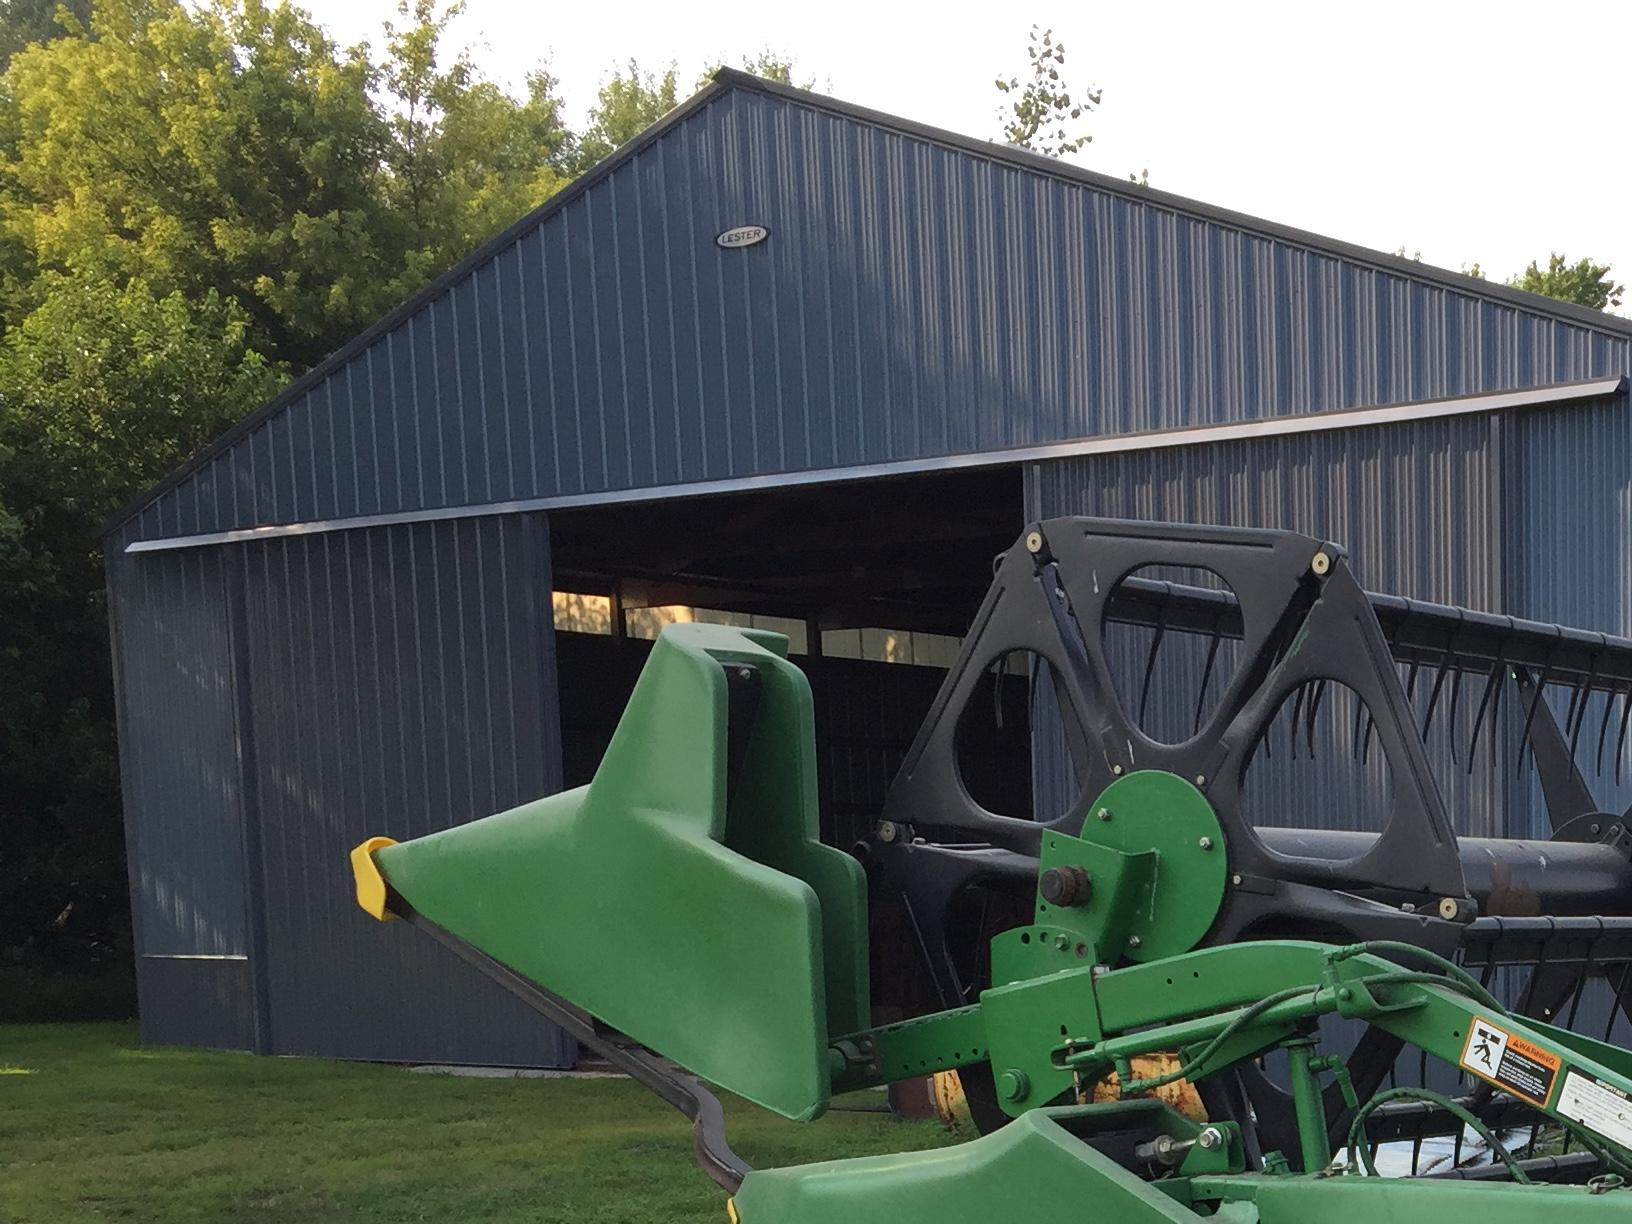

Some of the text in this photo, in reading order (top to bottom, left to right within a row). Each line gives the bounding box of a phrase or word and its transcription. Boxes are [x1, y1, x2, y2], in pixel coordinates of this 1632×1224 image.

[721, 229, 762, 244] LESTER
[1517, 1042, 1556, 1066] WARNING
[1595, 1078, 1628, 1099] IMPORTANT
